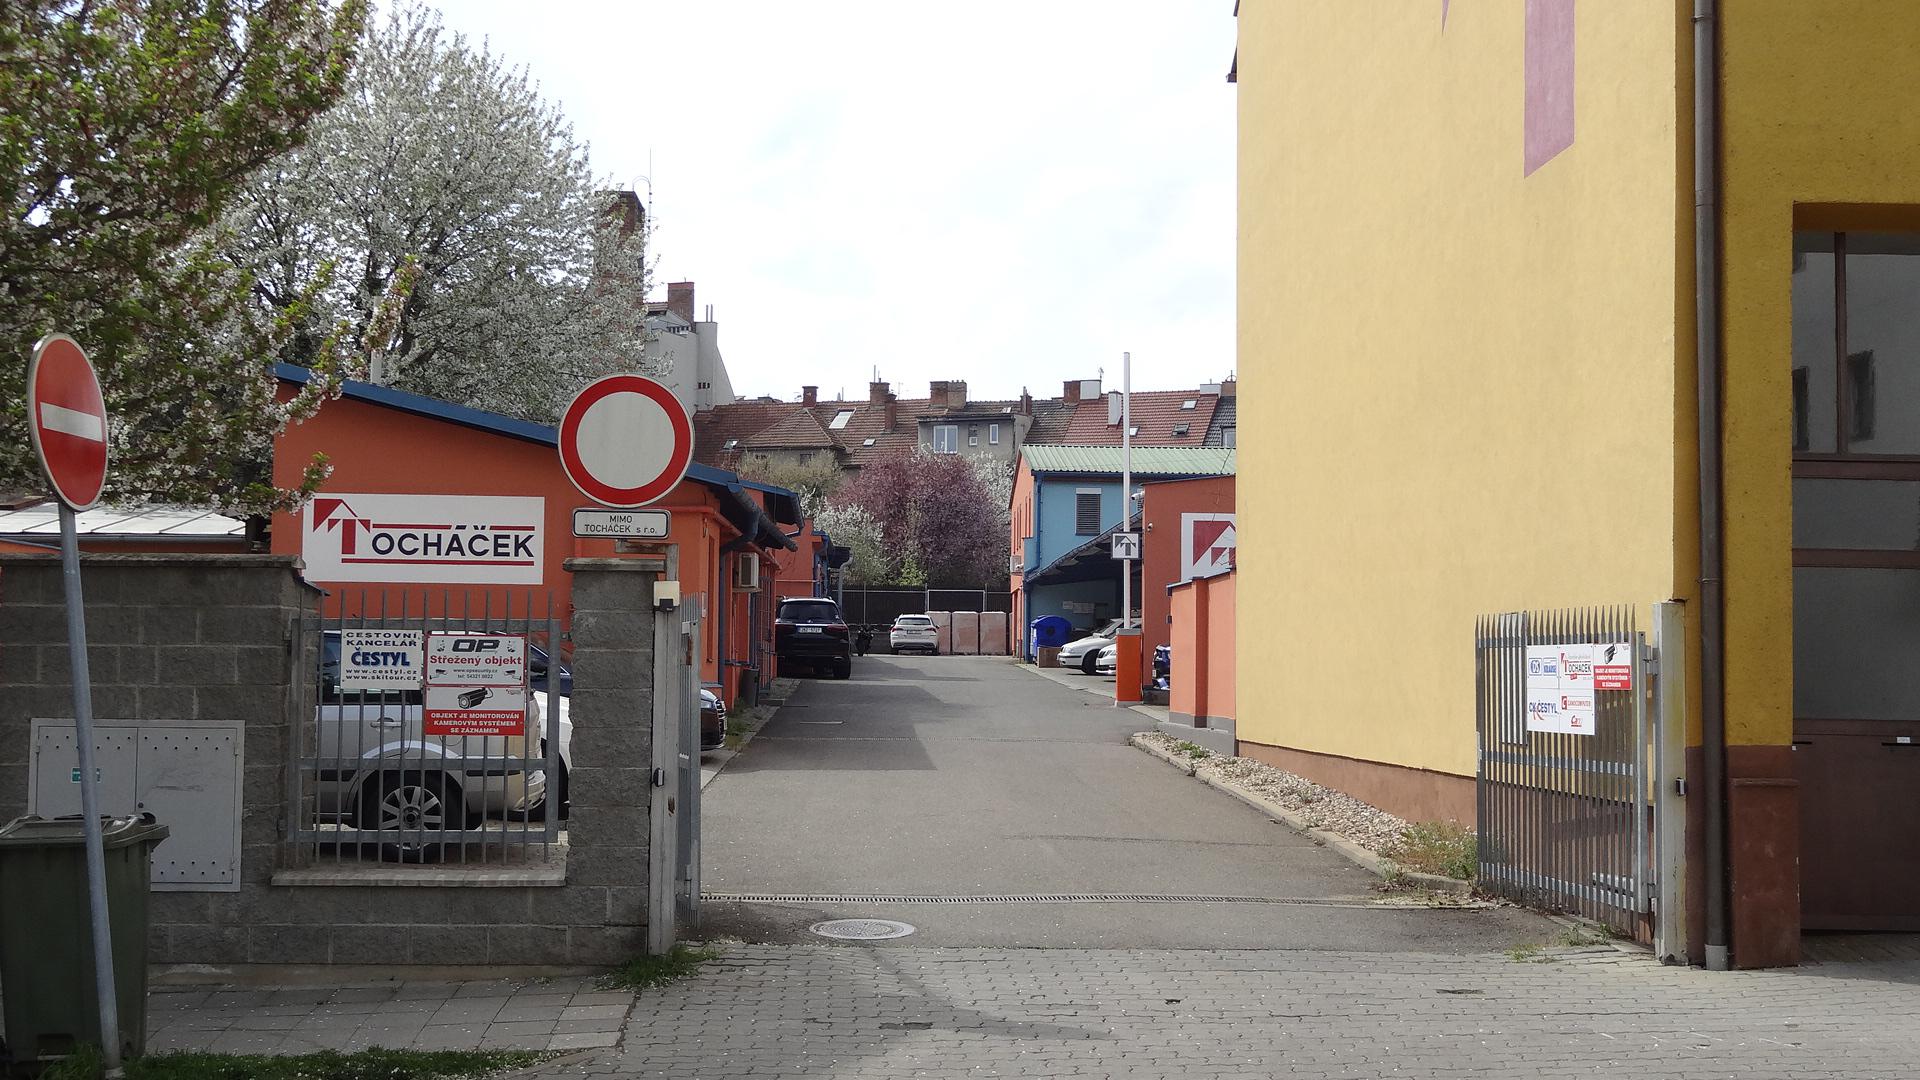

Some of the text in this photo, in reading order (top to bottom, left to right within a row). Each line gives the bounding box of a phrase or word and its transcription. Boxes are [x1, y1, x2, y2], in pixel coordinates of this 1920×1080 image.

[609, 515, 633, 523] MIMO
[584, 523, 631, 533] TOCHÁČEK
[346, 639, 417, 647] KANCELÁŘ
[452, 639, 501, 653] OP
[351, 646, 410, 667] ČESTYL
[430, 655, 522, 667] Střežený objekt
